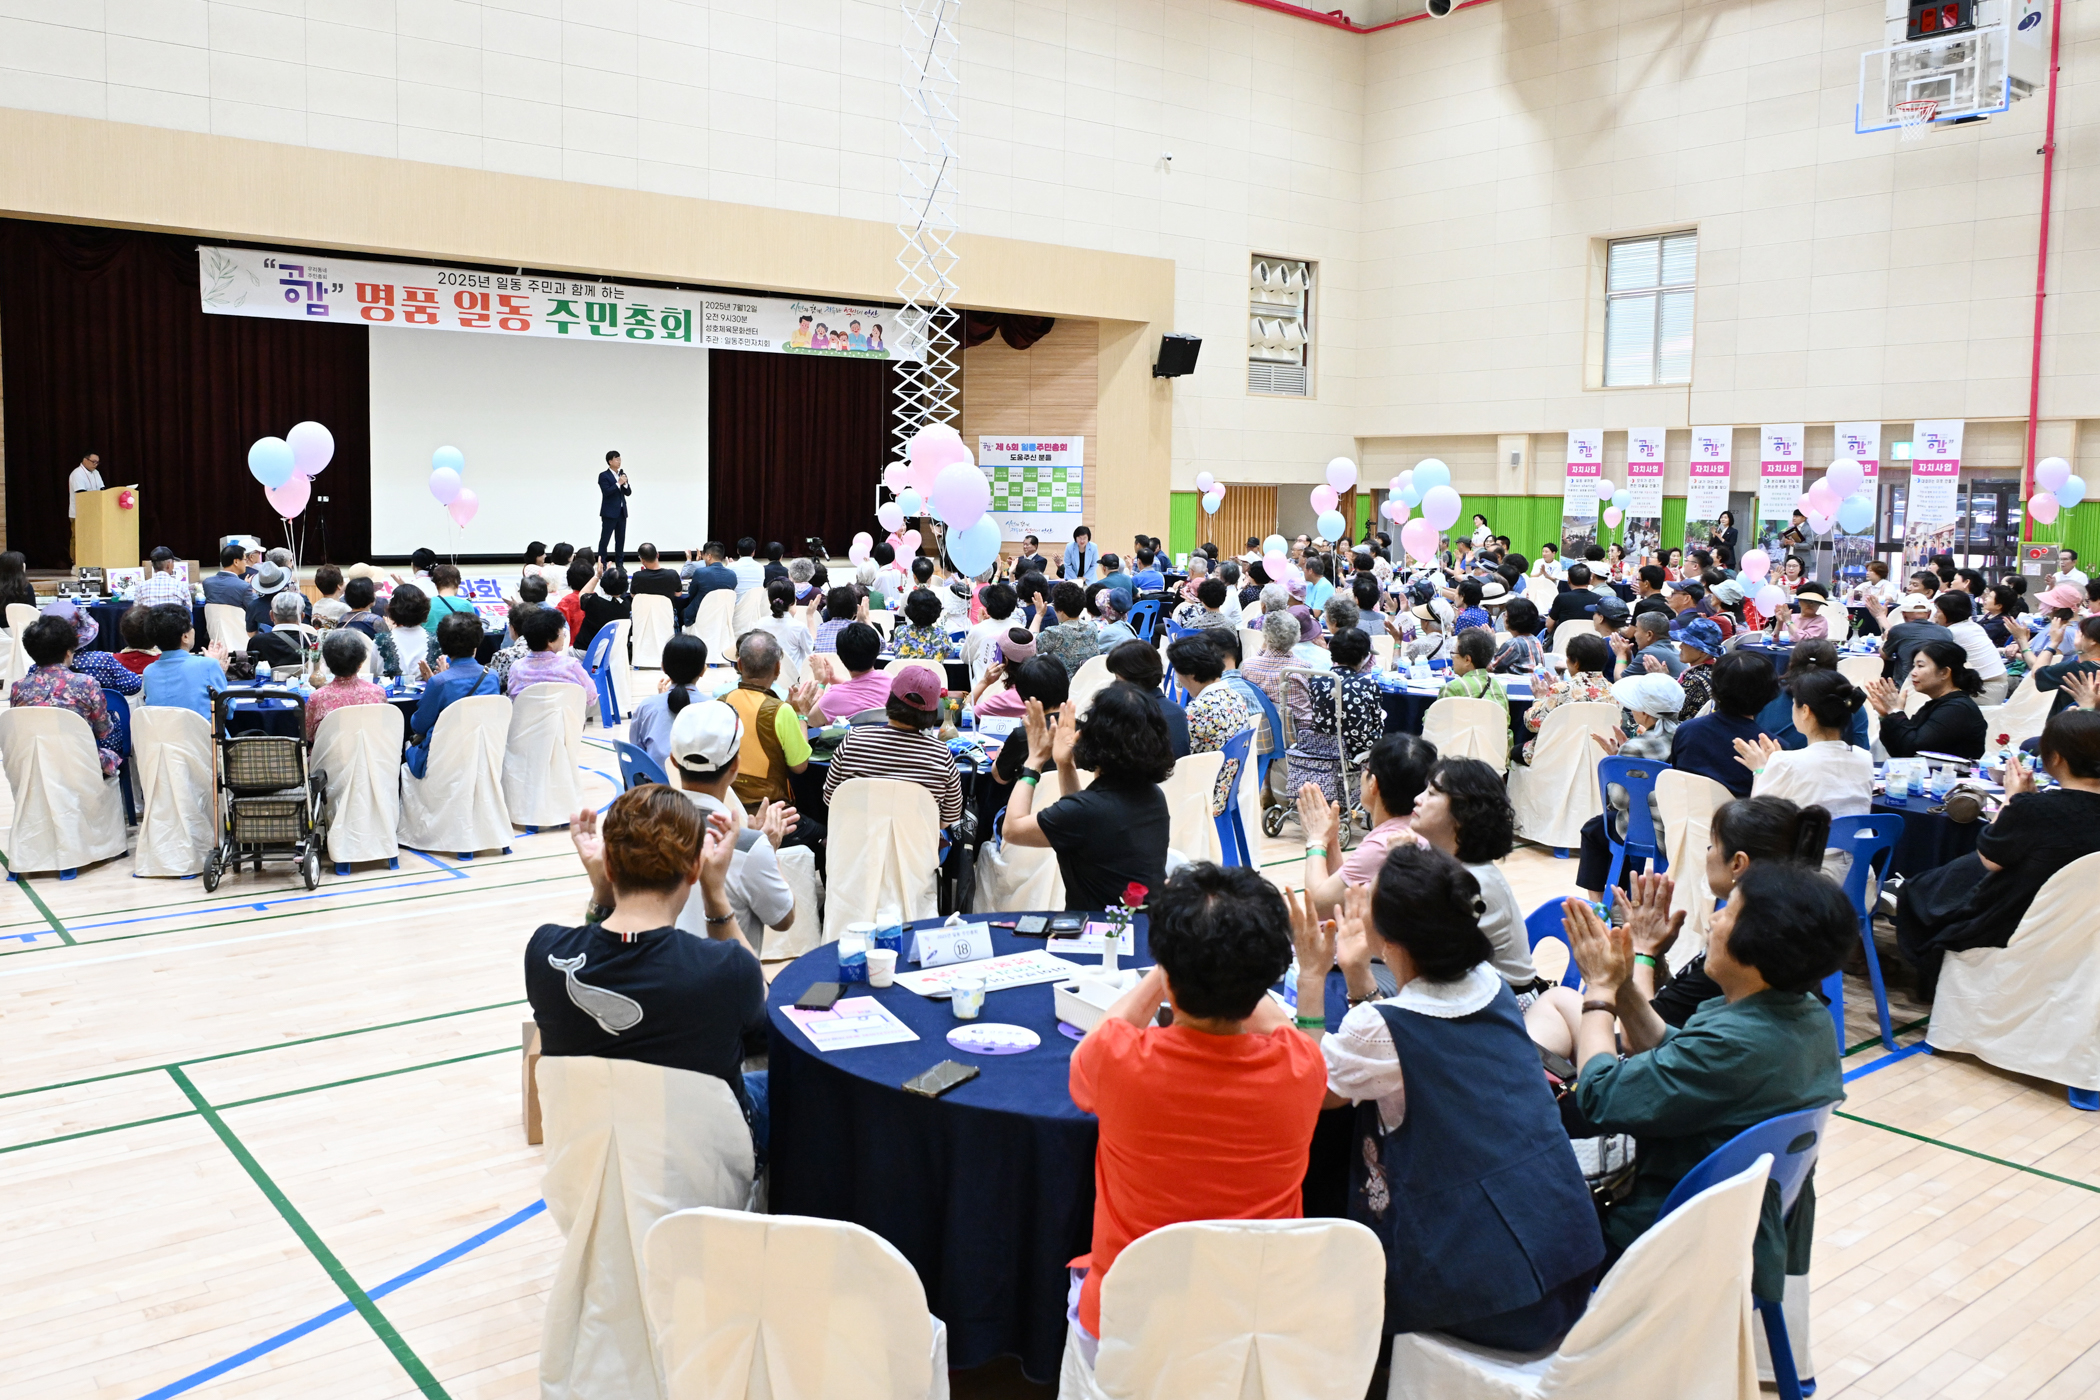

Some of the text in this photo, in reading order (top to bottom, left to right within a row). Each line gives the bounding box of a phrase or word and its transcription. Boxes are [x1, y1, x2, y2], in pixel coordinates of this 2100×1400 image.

[307, 272, 328, 280] 주민총회
[437, 271, 626, 300] 2025년 일동 주민과 함께 하는
[354, 281, 692, 343] 명품 일동 주민총회
[705, 301, 758, 314] 2025년 7월12일
[705, 313, 748, 324] 오전 9시30분
[705, 324, 759, 336] 성호체육문화센터
[705, 335, 720, 344] 주관
[724, 336, 771, 348] 일동주민자치회
[995, 442, 1004, 452] 제
[1005, 442, 1019, 452] 6회
[1009, 453, 1052, 462] 도움주신 분들
[1571, 465, 1597, 474] 자치사업
[1632, 465, 1659, 473] 자치사업
[1695, 464, 1725, 473] 자치사업
[1767, 464, 1797, 473] 자치사업
[1918, 463, 1953, 472] 자치사업
[956, 943, 969, 956] 18
